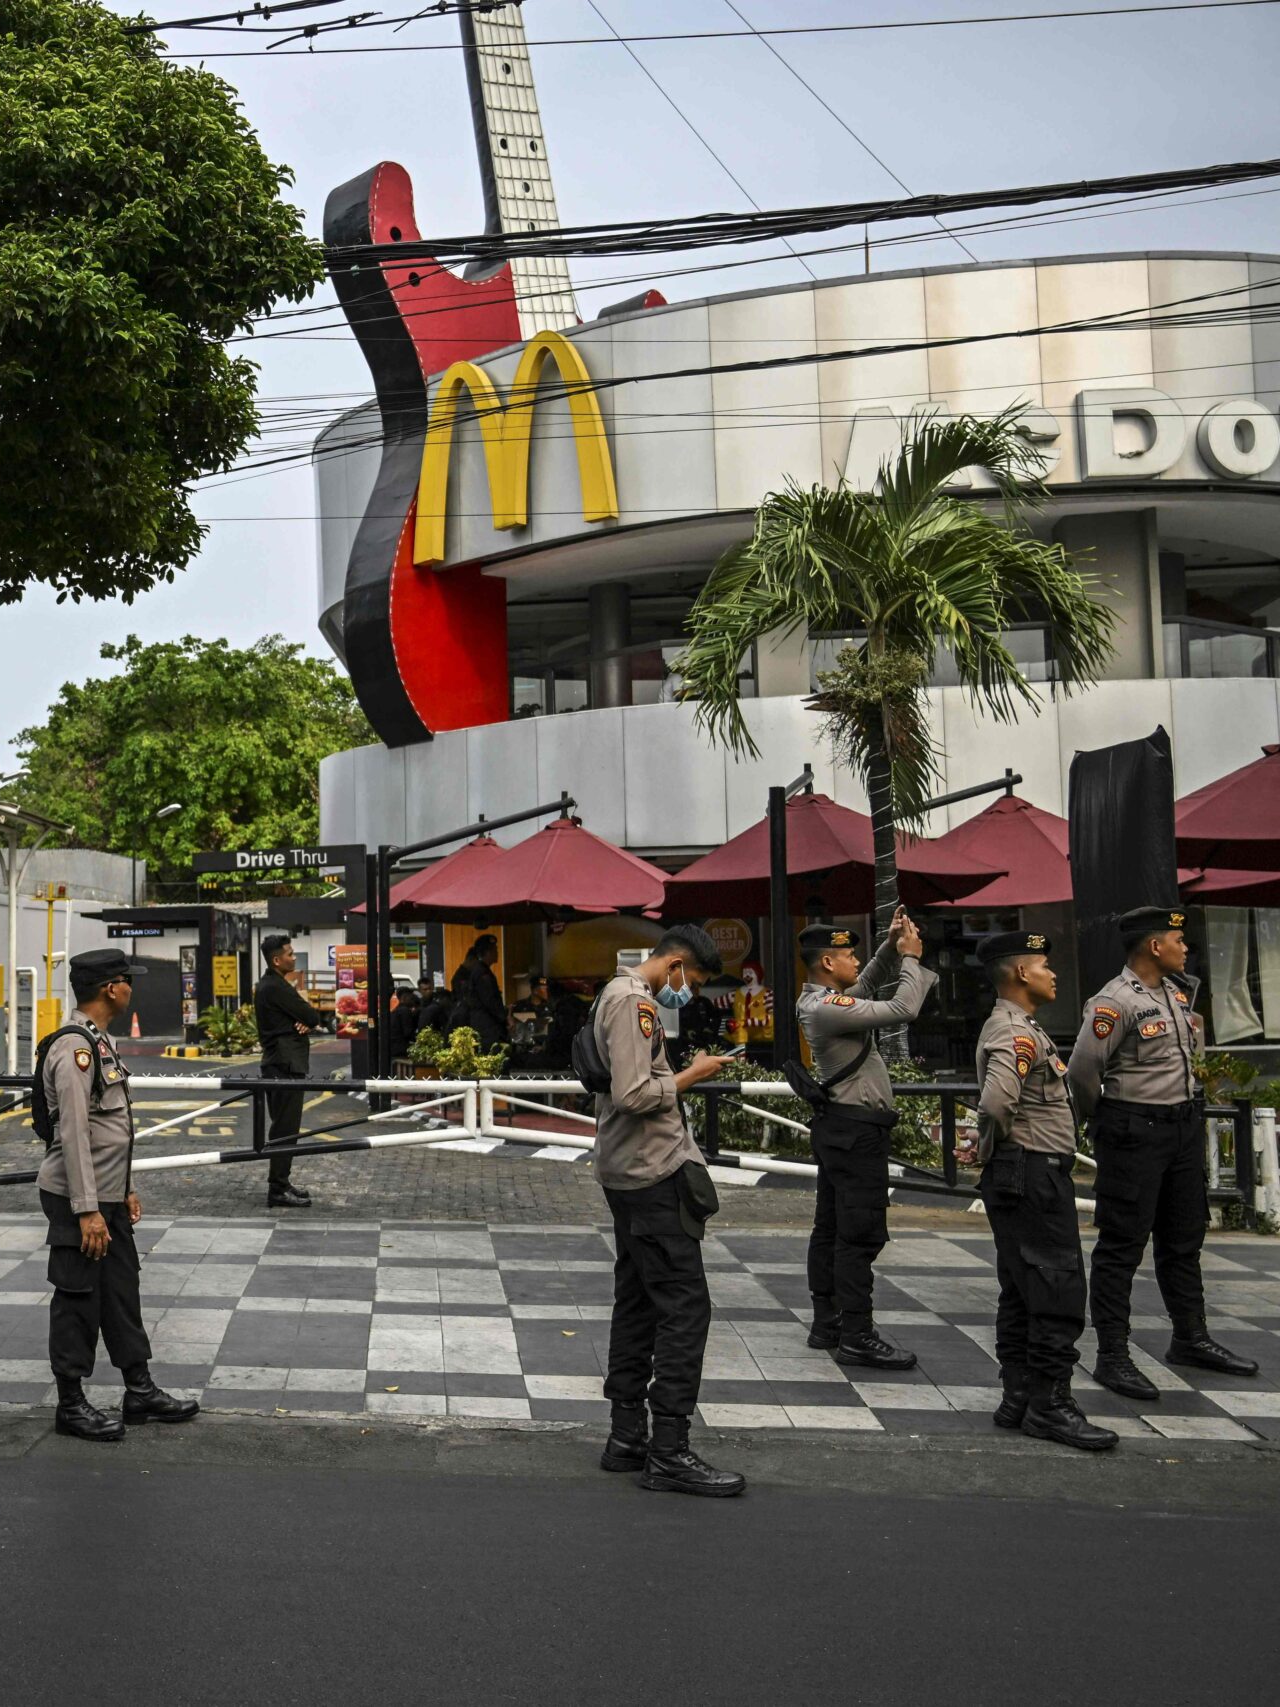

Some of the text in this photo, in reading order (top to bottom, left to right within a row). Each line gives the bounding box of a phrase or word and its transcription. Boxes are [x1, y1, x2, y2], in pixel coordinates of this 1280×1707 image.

[236, 849, 328, 868] Drive Thru
[712, 927, 738, 939] BEST
